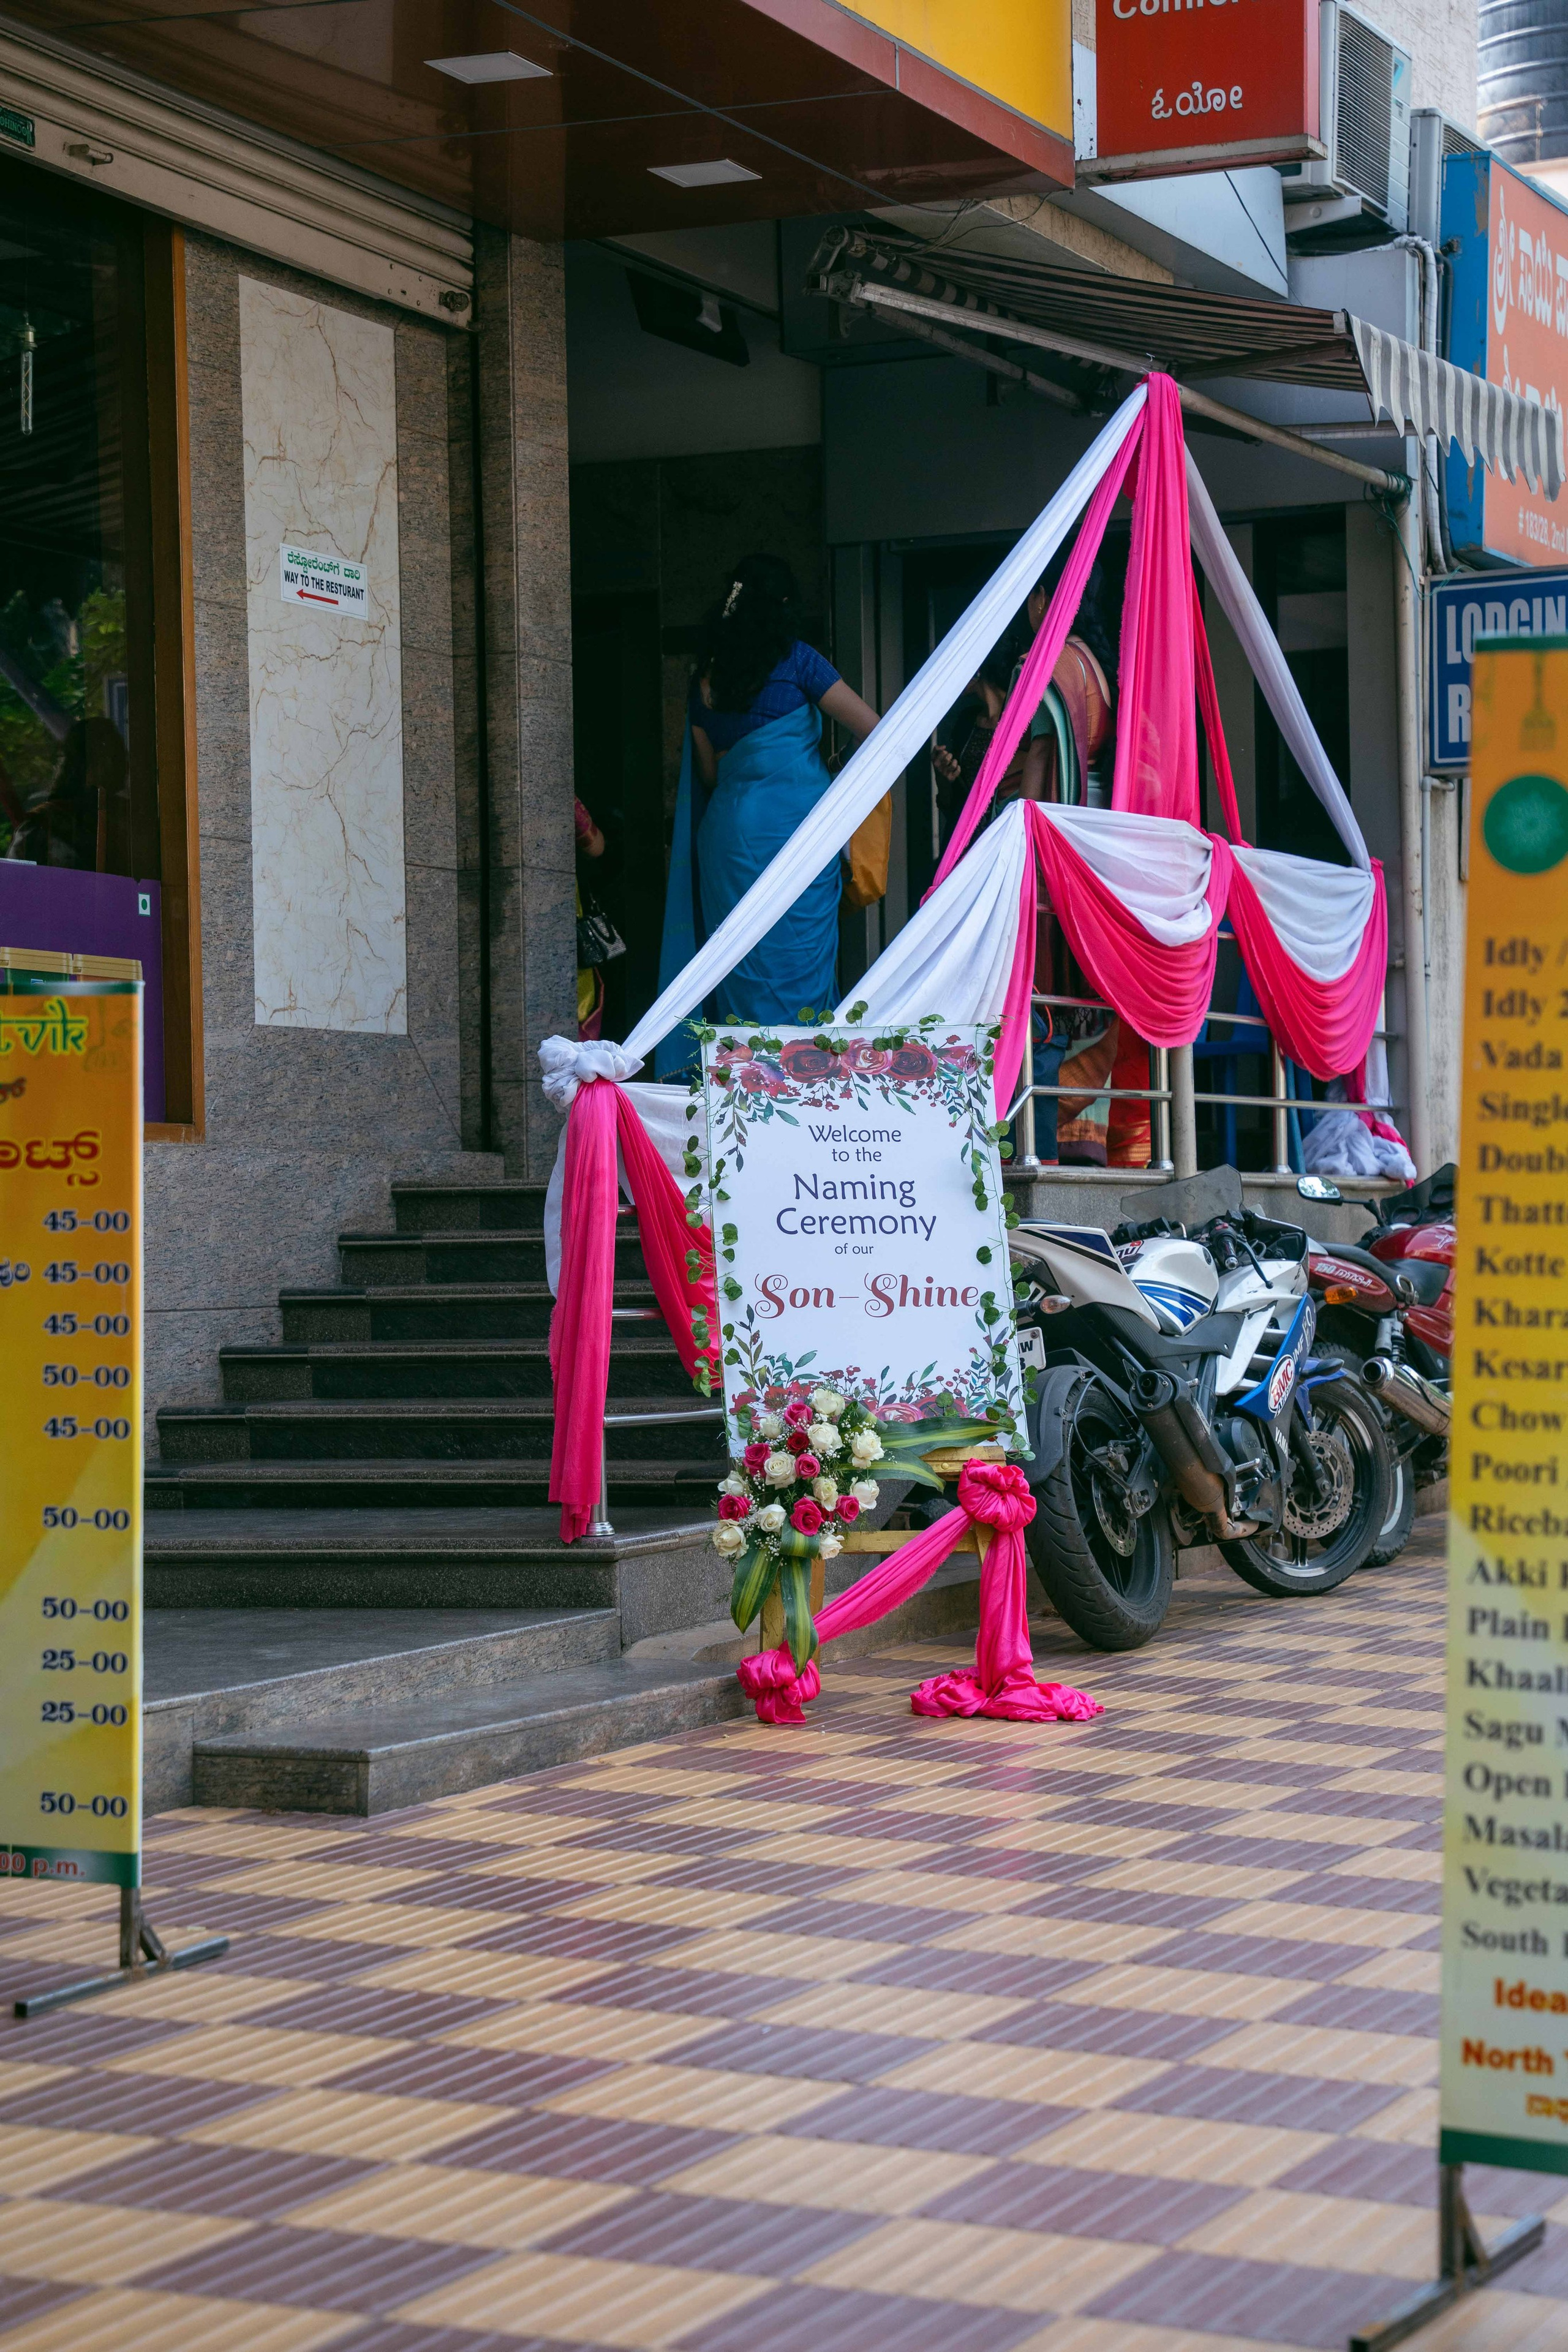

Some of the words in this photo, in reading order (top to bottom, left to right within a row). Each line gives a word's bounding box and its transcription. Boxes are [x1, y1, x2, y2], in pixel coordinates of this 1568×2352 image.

[1152, 81, 1243, 119] ಓಯೋ
[284, 570, 299, 584] WAY
[300, 575, 309, 587] TO
[311, 577, 324, 591] THE
[326, 581, 364, 601] RESTURANT
[344, 567, 361, 580] ದಾರಿ
[1484, 937, 1547, 975] Idly
[1483, 990, 1546, 1027] Idly
[1482, 1041, 1563, 1070] Vada
[808, 1124, 902, 1143] Welcome
[832, 1148, 850, 1162] to
[855, 1147, 882, 1162] the
[1478, 1144, 1568, 1174] Doub
[793, 1172, 916, 1208] Naming
[43, 1210, 130, 1232] 45-00
[1476, 1194, 1568, 1224] Thatt
[776, 1207, 937, 1242] Ceremony
[835, 1242, 848, 1255] of
[852, 1245, 874, 1255] our
[1475, 1246, 1565, 1277] Kotte
[43, 1262, 129, 1284] 45-00
[43, 1314, 130, 1336] 45-00
[43, 1365, 130, 1388] 50-00
[1271, 1360, 1293, 1408] BMC
[43, 1417, 130, 1441] 45-00
[1471, 1400, 1566, 1431] Chow
[1471, 1452, 1559, 1485] Poori
[43, 1507, 130, 1530] 50-00
[1467, 1558, 1547, 1589] Akki
[42, 1597, 129, 1622] 50-00
[1466, 1606, 1550, 1640] Plain
[42, 1649, 128, 1674] 25-00
[41, 1701, 128, 1726] 25-00
[1463, 1711, 1544, 1752] Sagu
[1463, 1762, 1550, 1802] Open
[40, 1792, 128, 1817] 50-00
[1463, 1815, 1568, 1852] Masal
[33, 1858, 85, 1877] p.m.
[1461, 1920, 1548, 1956] South
[1461, 2038, 1554, 2076] North
